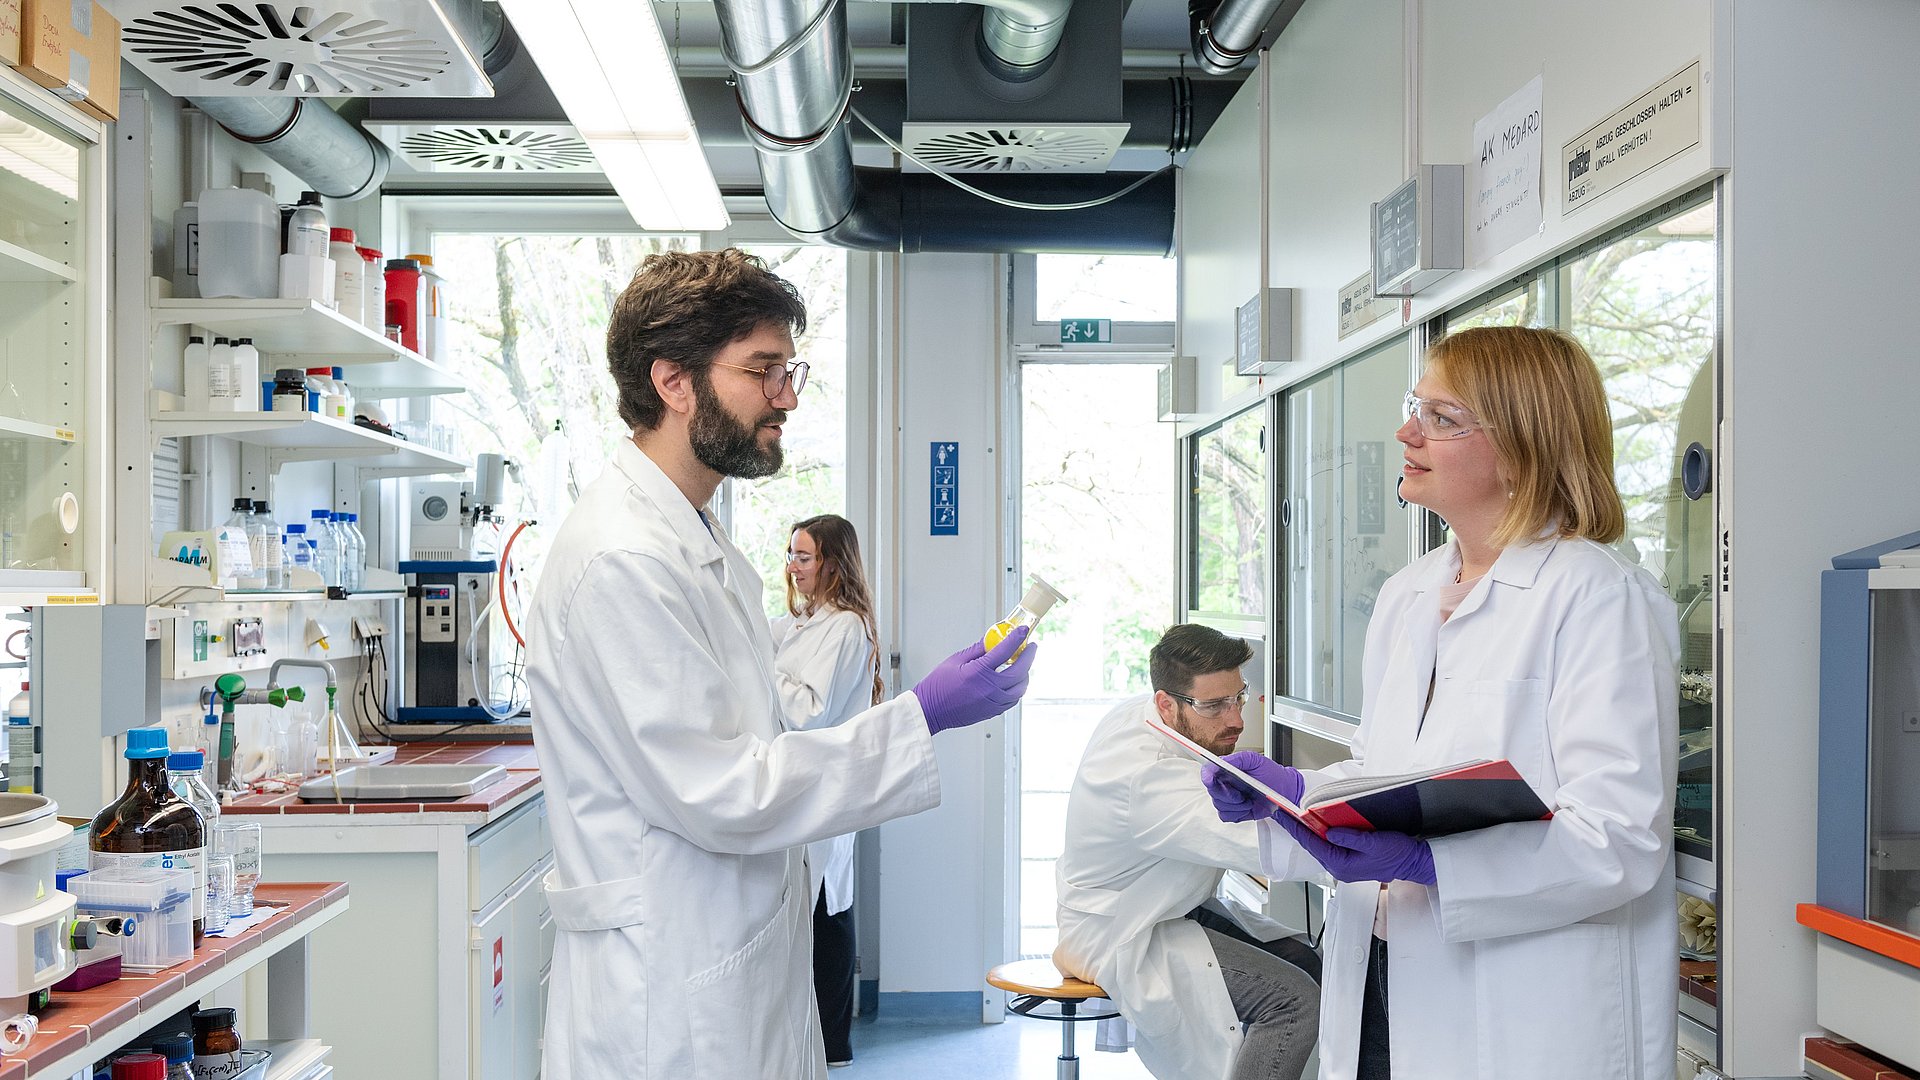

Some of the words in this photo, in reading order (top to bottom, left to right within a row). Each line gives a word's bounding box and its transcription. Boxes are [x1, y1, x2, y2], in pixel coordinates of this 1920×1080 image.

[1480, 133, 1495, 169] AK
[1501, 110, 1540, 156] MEDARD
[1595, 130, 1614, 151] ABZUG
[1615, 103, 1657, 138] GESCHLOSSEN
[1659, 87, 1684, 113] HALTEN
[1595, 151, 1616, 172] UNFALL
[1617, 131, 1649, 159] VERHÜTEN
[1568, 185, 1586, 203] ABZUG
